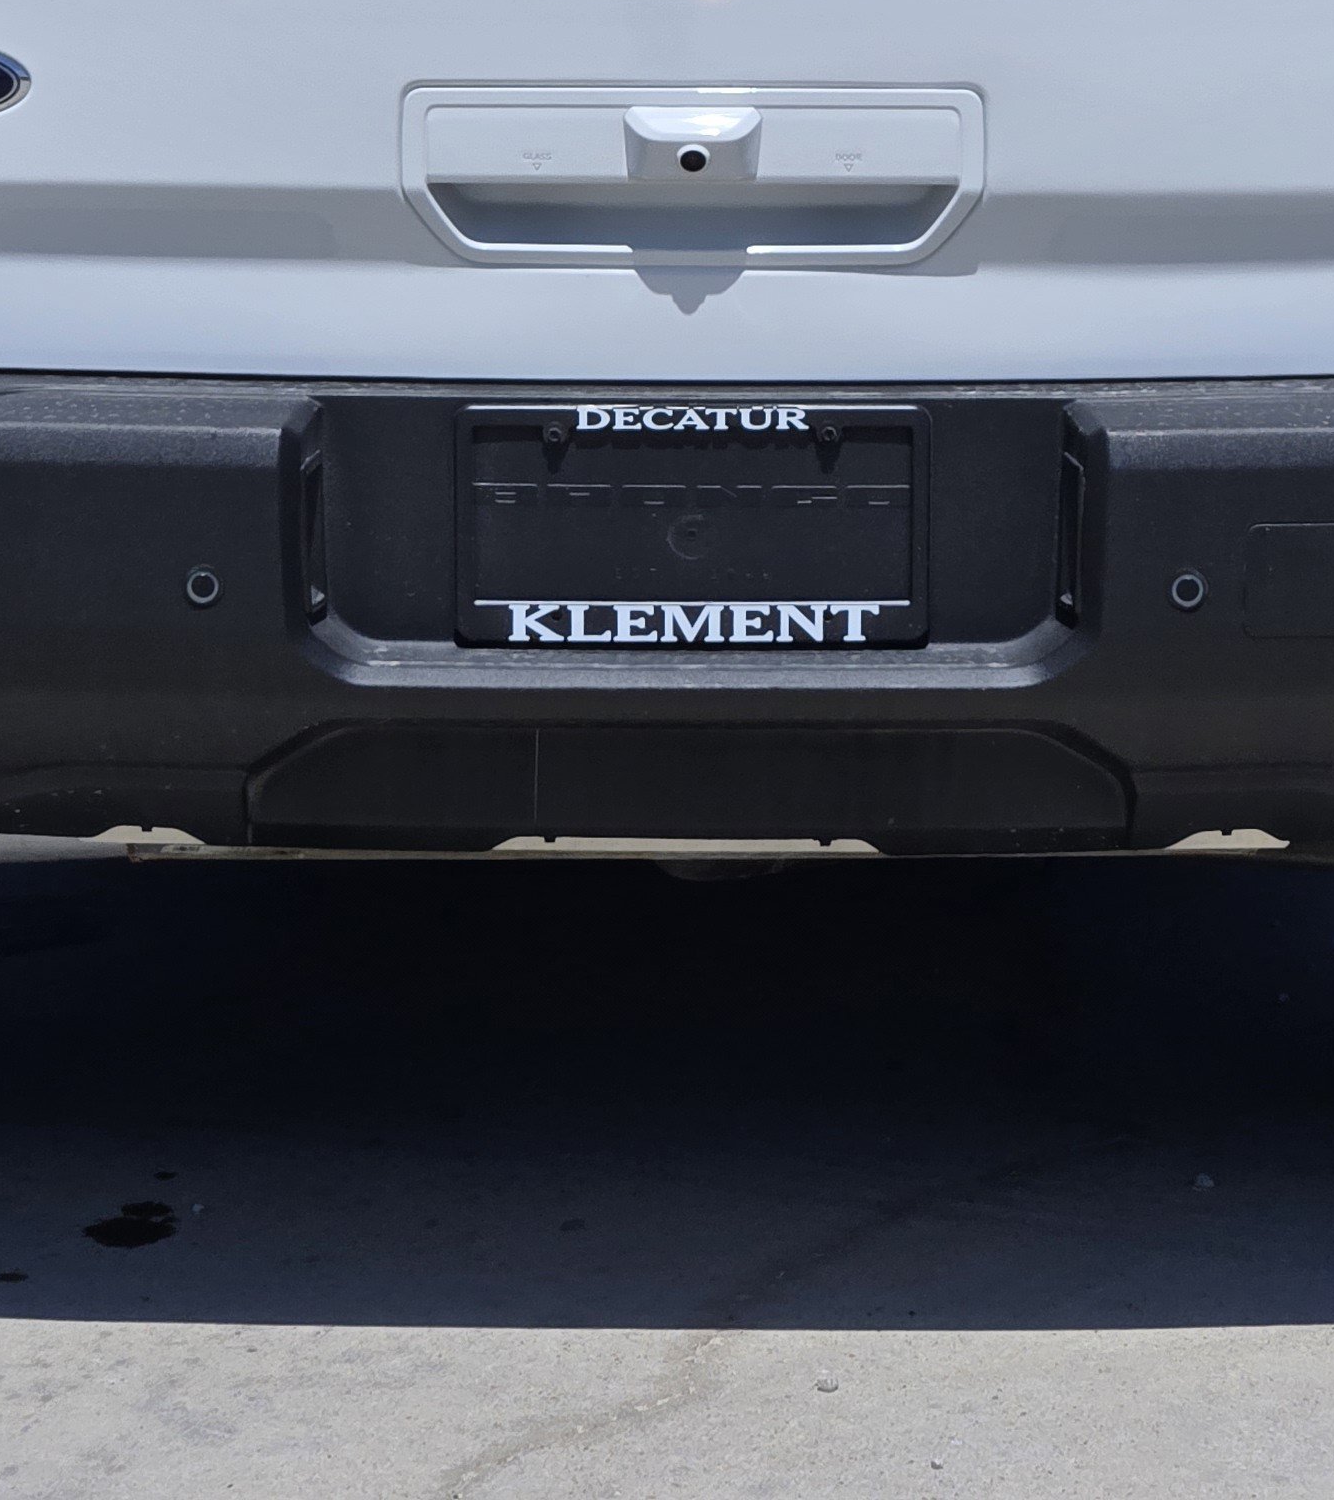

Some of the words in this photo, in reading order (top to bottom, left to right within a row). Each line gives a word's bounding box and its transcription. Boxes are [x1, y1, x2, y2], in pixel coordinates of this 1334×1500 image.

[522, 153, 553, 162] GLASS
[835, 153, 863, 162] DOOR
[575, 407, 811, 431] DECATUR
[507, 603, 880, 644] KLEMENT
